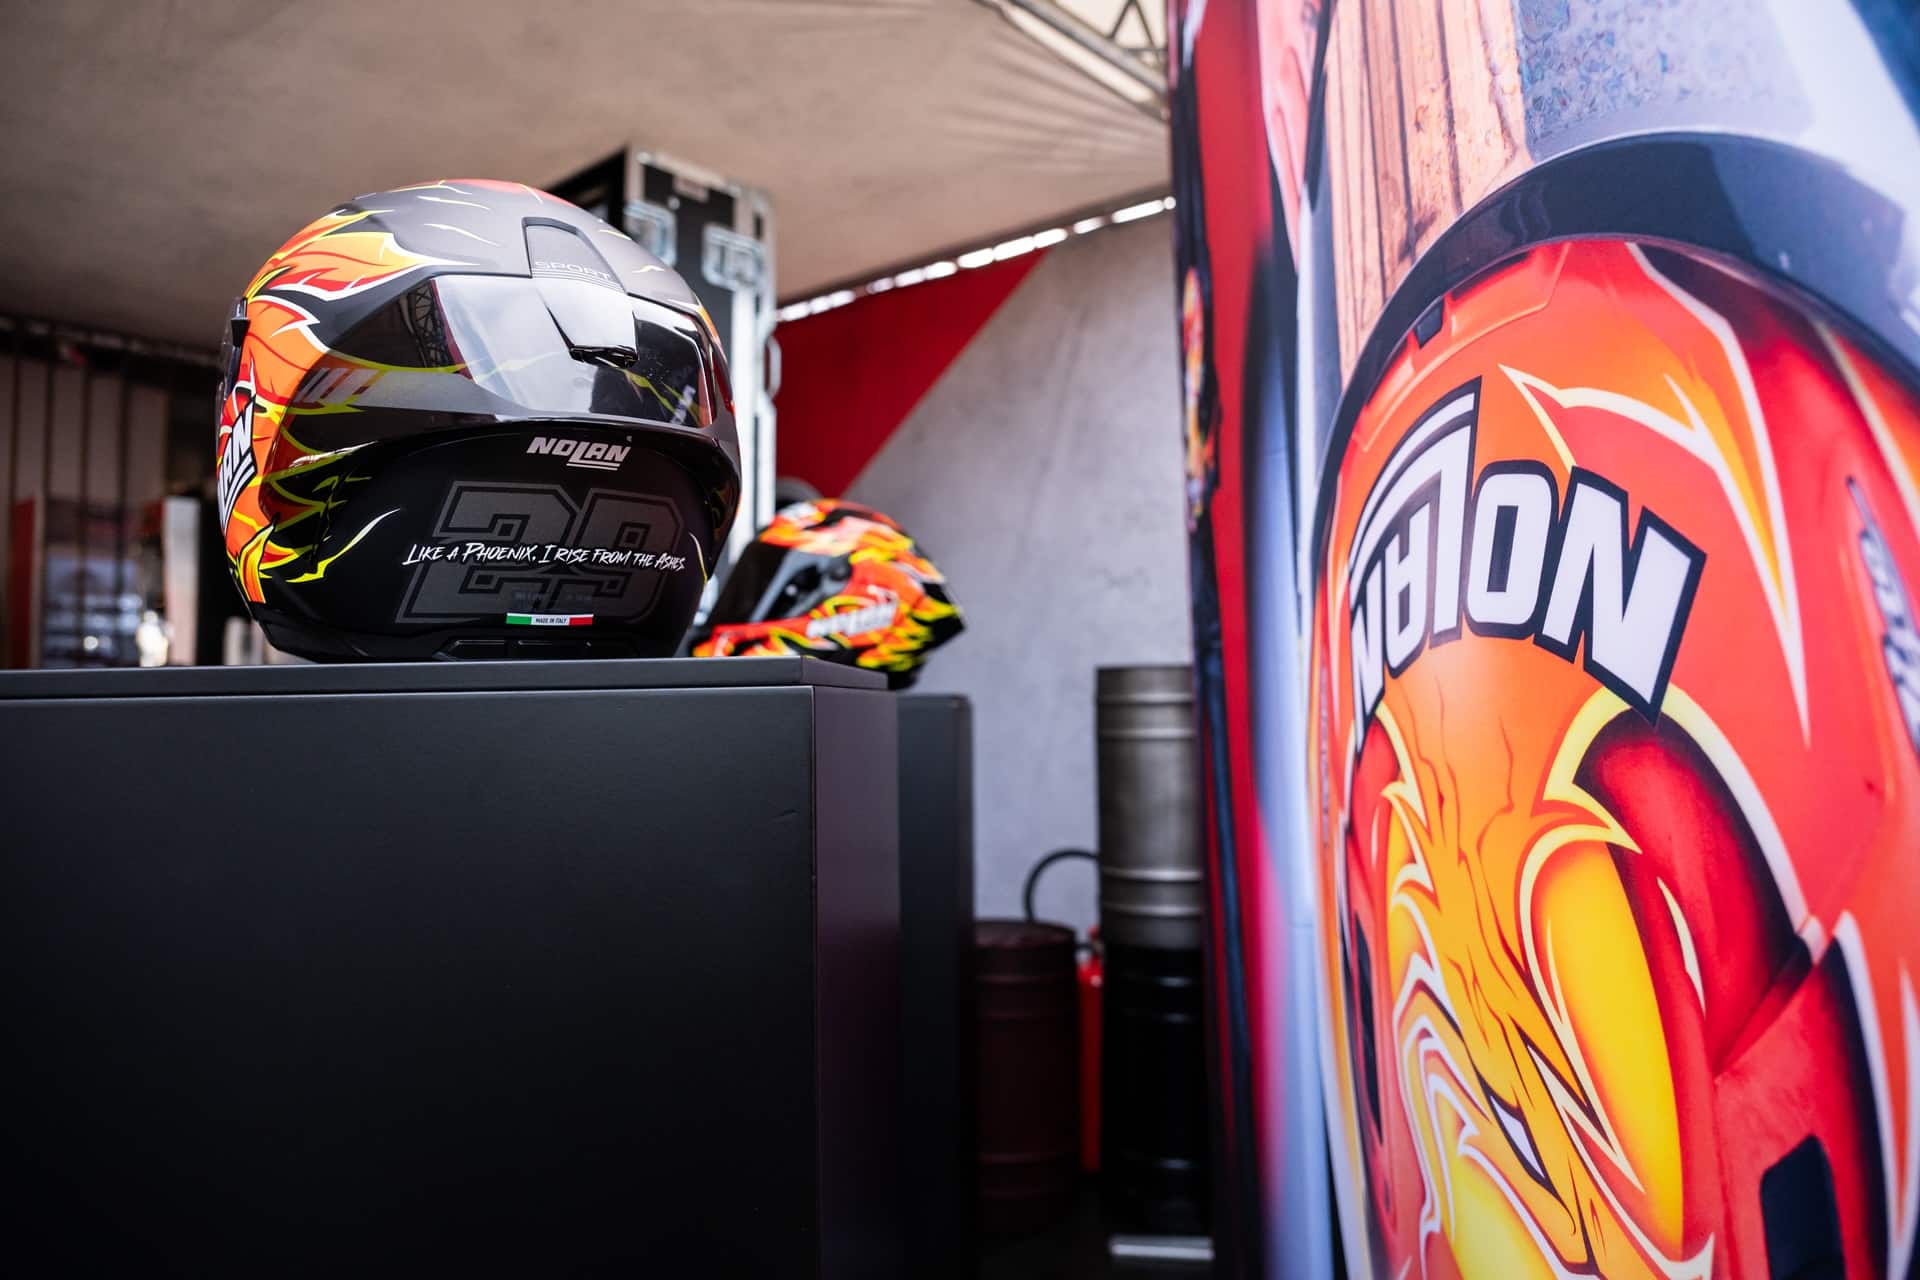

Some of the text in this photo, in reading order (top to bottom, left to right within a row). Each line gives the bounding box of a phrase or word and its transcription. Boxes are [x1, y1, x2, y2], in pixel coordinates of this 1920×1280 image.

[534, 260, 612, 281] SPORT
[526, 436, 632, 471] NOLAN
[538, 544, 558, 564] I
[553, 547, 592, 565] RISE
[591, 548, 633, 565] FROM
[632, 552, 656, 567] THE
[1348, 376, 1707, 760] NOLAN
